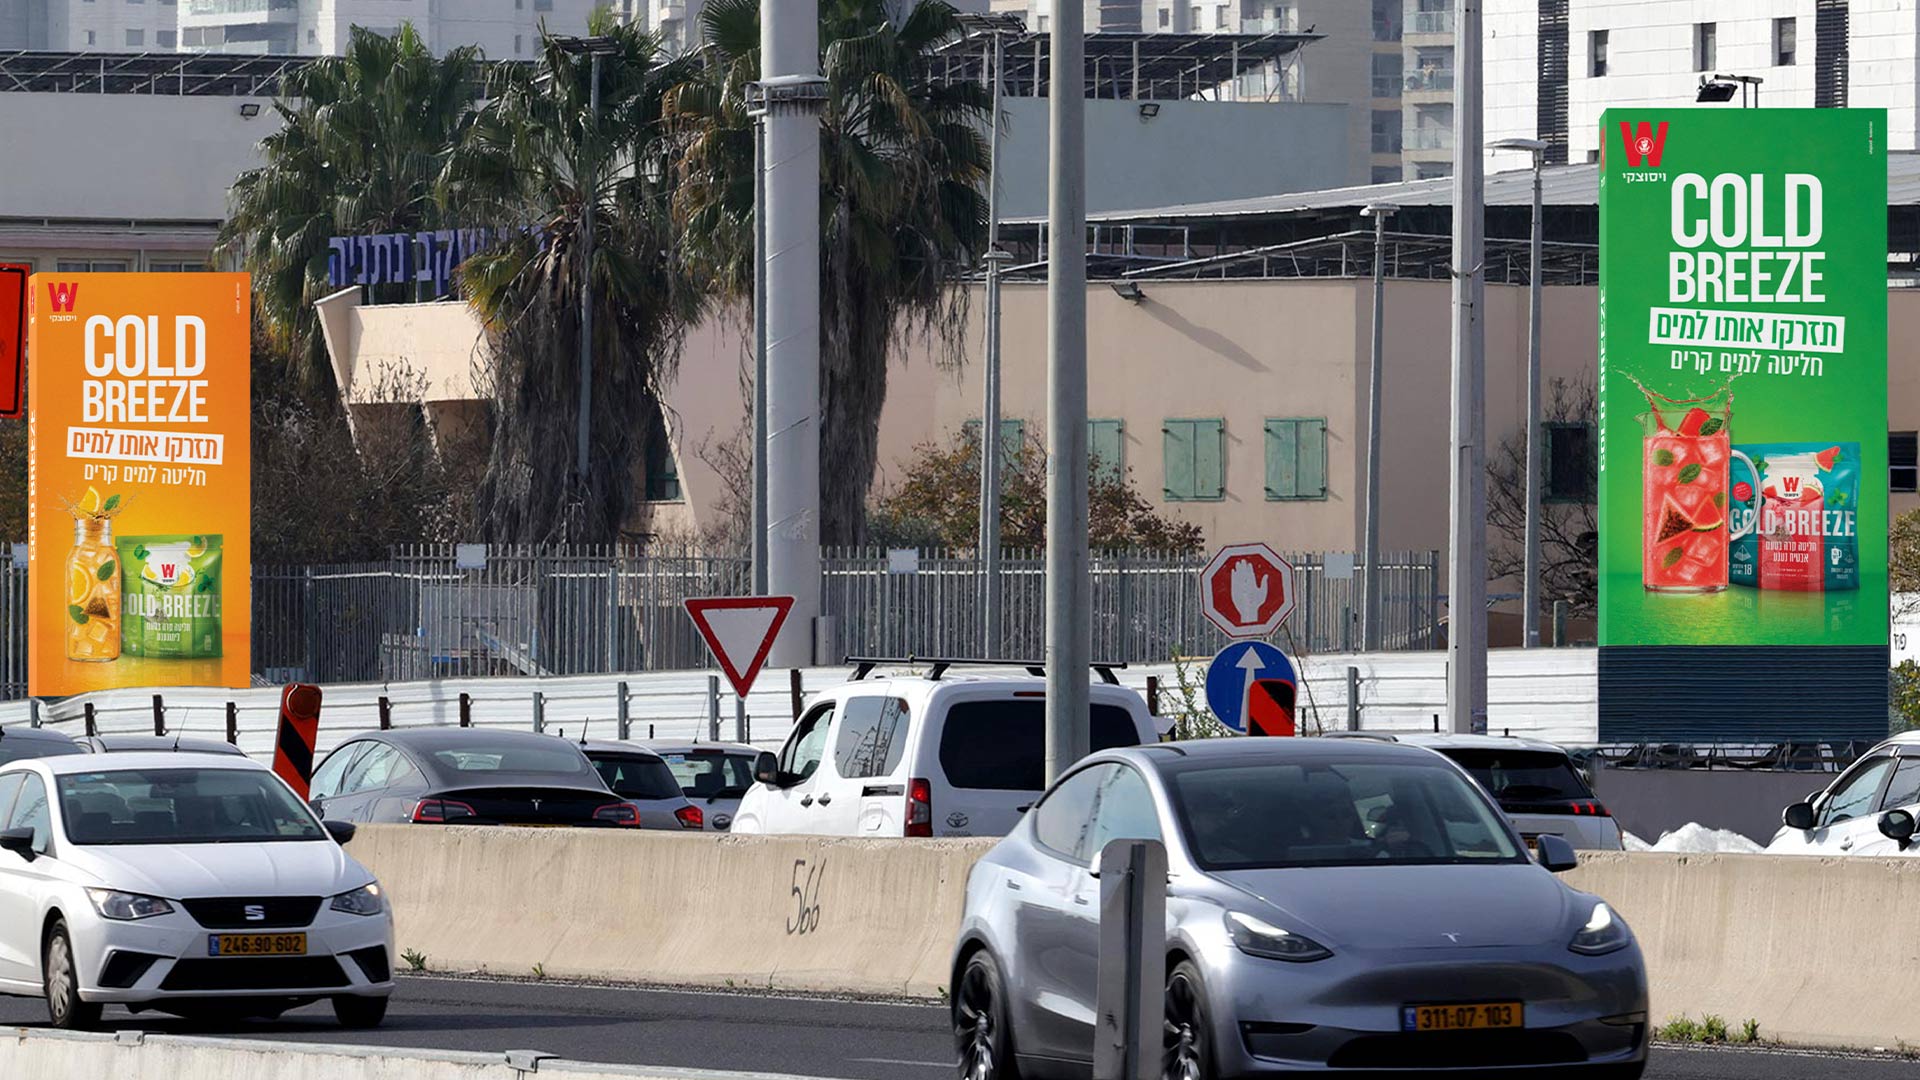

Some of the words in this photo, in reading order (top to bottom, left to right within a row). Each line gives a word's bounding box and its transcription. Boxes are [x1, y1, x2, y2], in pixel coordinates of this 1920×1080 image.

[1622, 172, 1667, 184] ויסוצקי
[1672, 173, 1823, 249] COLD
[329, 232, 408, 286] נתניה
[1669, 251, 1826, 303] BREEZE
[1657, 311, 1708, 339] למים
[1714, 316, 1764, 343] אותו
[1771, 319, 1837, 349] תזרקו
[84, 314, 206, 378] COLD
[1671, 350, 1712, 375] קרים
[1719, 350, 1762, 374] למים
[1767, 353, 1823, 377] חליטה
[82, 379, 208, 423] BREEZE
[72, 430, 114, 454] למים
[119, 434, 159, 456] אותו
[165, 436, 218, 462] תזרקו
[84, 463, 118, 485] קרים
[123, 463, 156, 483] למים
[161, 466, 207, 486] חליטה
[1730, 508, 1777, 534] COLD
[1785, 509, 1855, 537] BREEZE
[163, 594, 220, 618] BREEZE
[786, 857, 827, 935] 566
